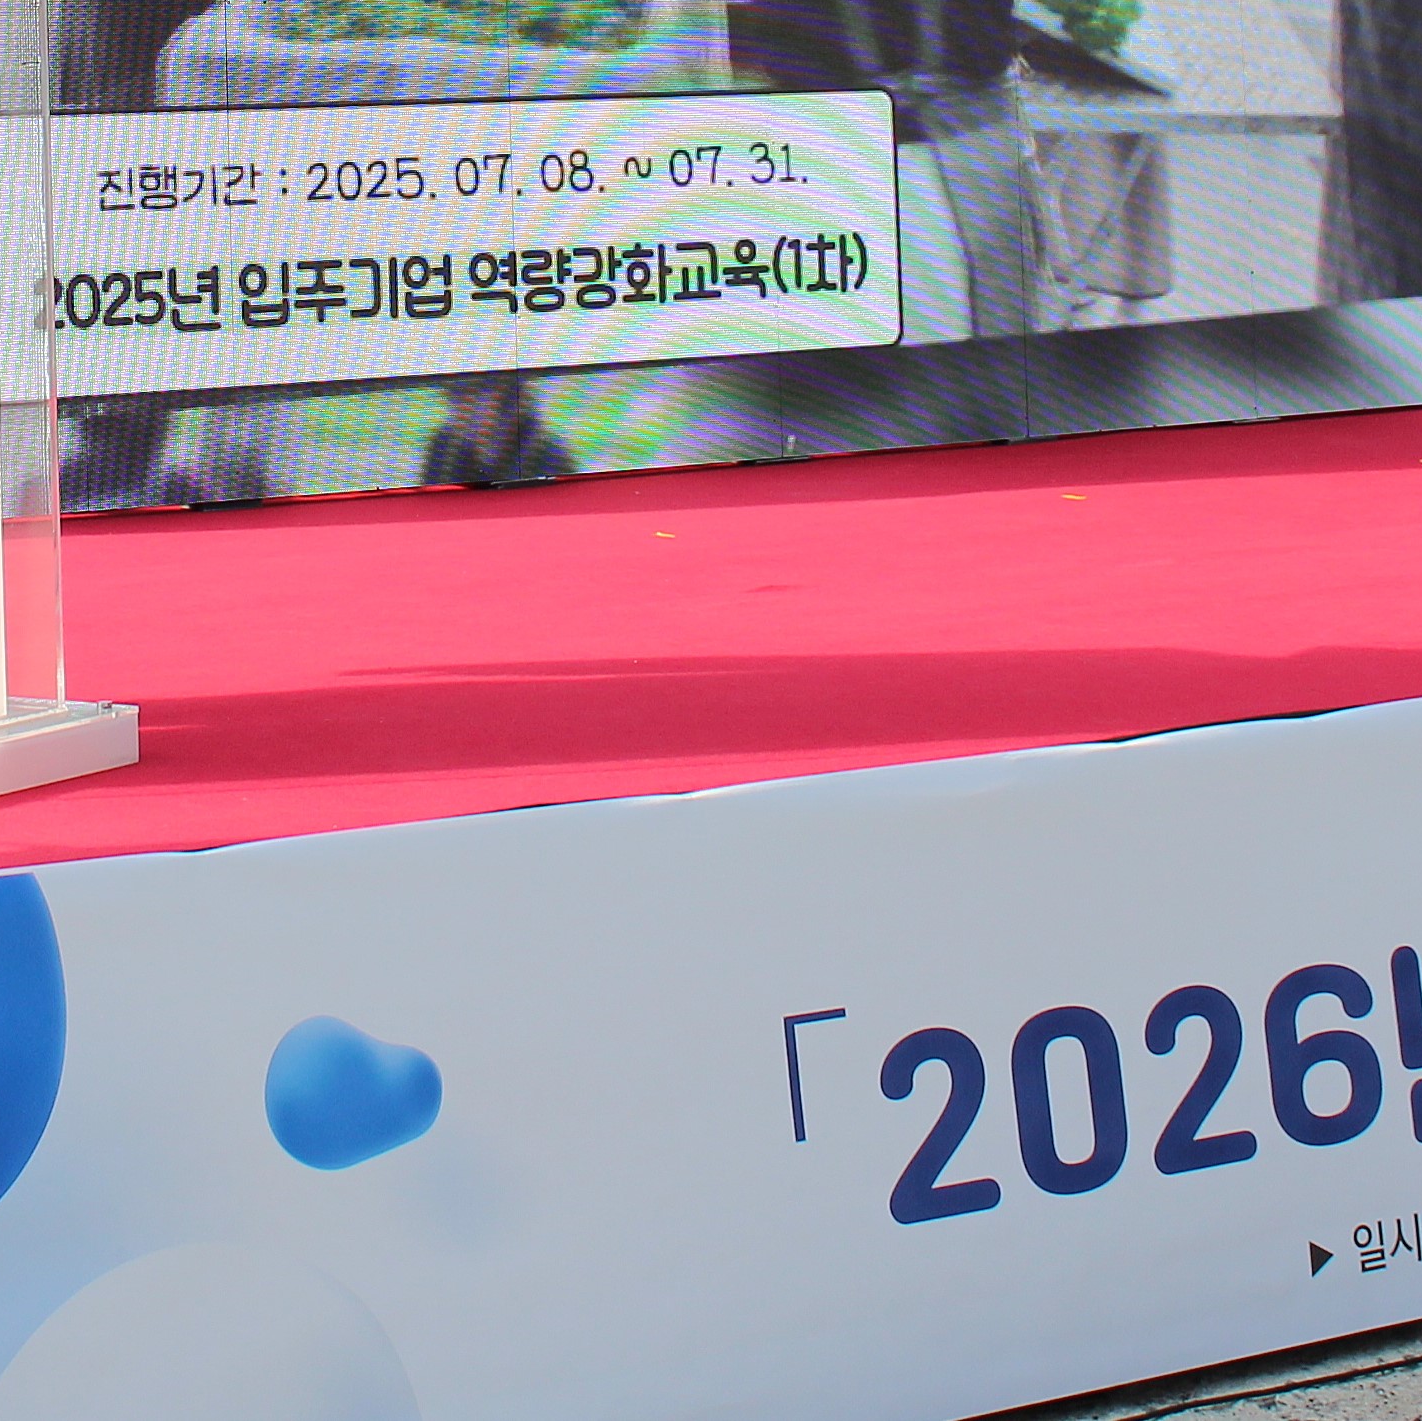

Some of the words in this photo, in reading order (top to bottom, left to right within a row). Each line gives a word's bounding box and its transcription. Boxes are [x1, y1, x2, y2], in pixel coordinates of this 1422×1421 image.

[96, 161, 265, 214] 진행기간
[307, 157, 437, 203] 2025.
[456, 153, 524, 198] 07.
[540, 150, 607, 194] 08.
[669, 144, 735, 189] 07.
[748, 140, 809, 185] 31.
[238, 256, 454, 327] 입주기업
[468, 231, 870, 315] 역량강화교육(1차)
